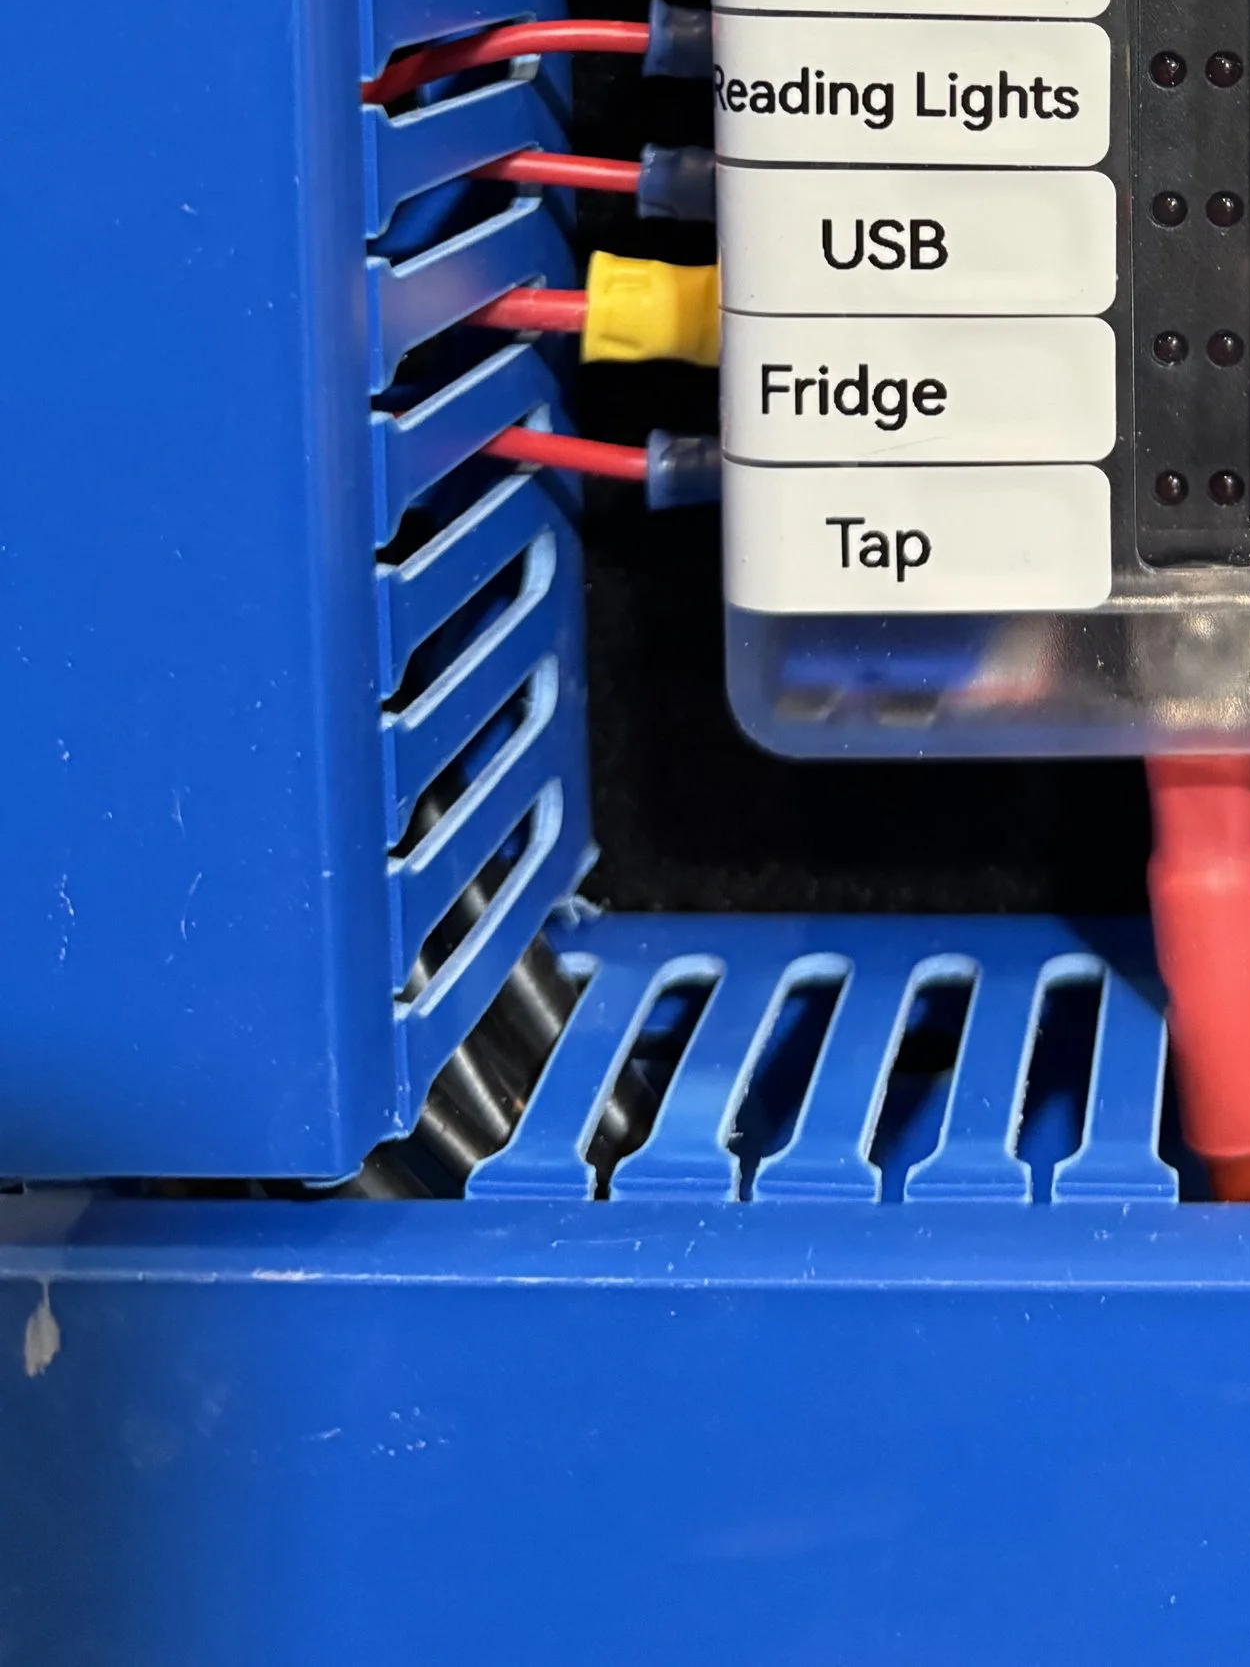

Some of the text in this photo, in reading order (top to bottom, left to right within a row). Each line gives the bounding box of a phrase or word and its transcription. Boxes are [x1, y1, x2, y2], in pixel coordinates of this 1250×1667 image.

[713, 63, 1080, 132] Reading Lights
[821, 218, 949, 271] USB
[761, 363, 948, 432] Fridge
[825, 517, 932, 583] Tap
